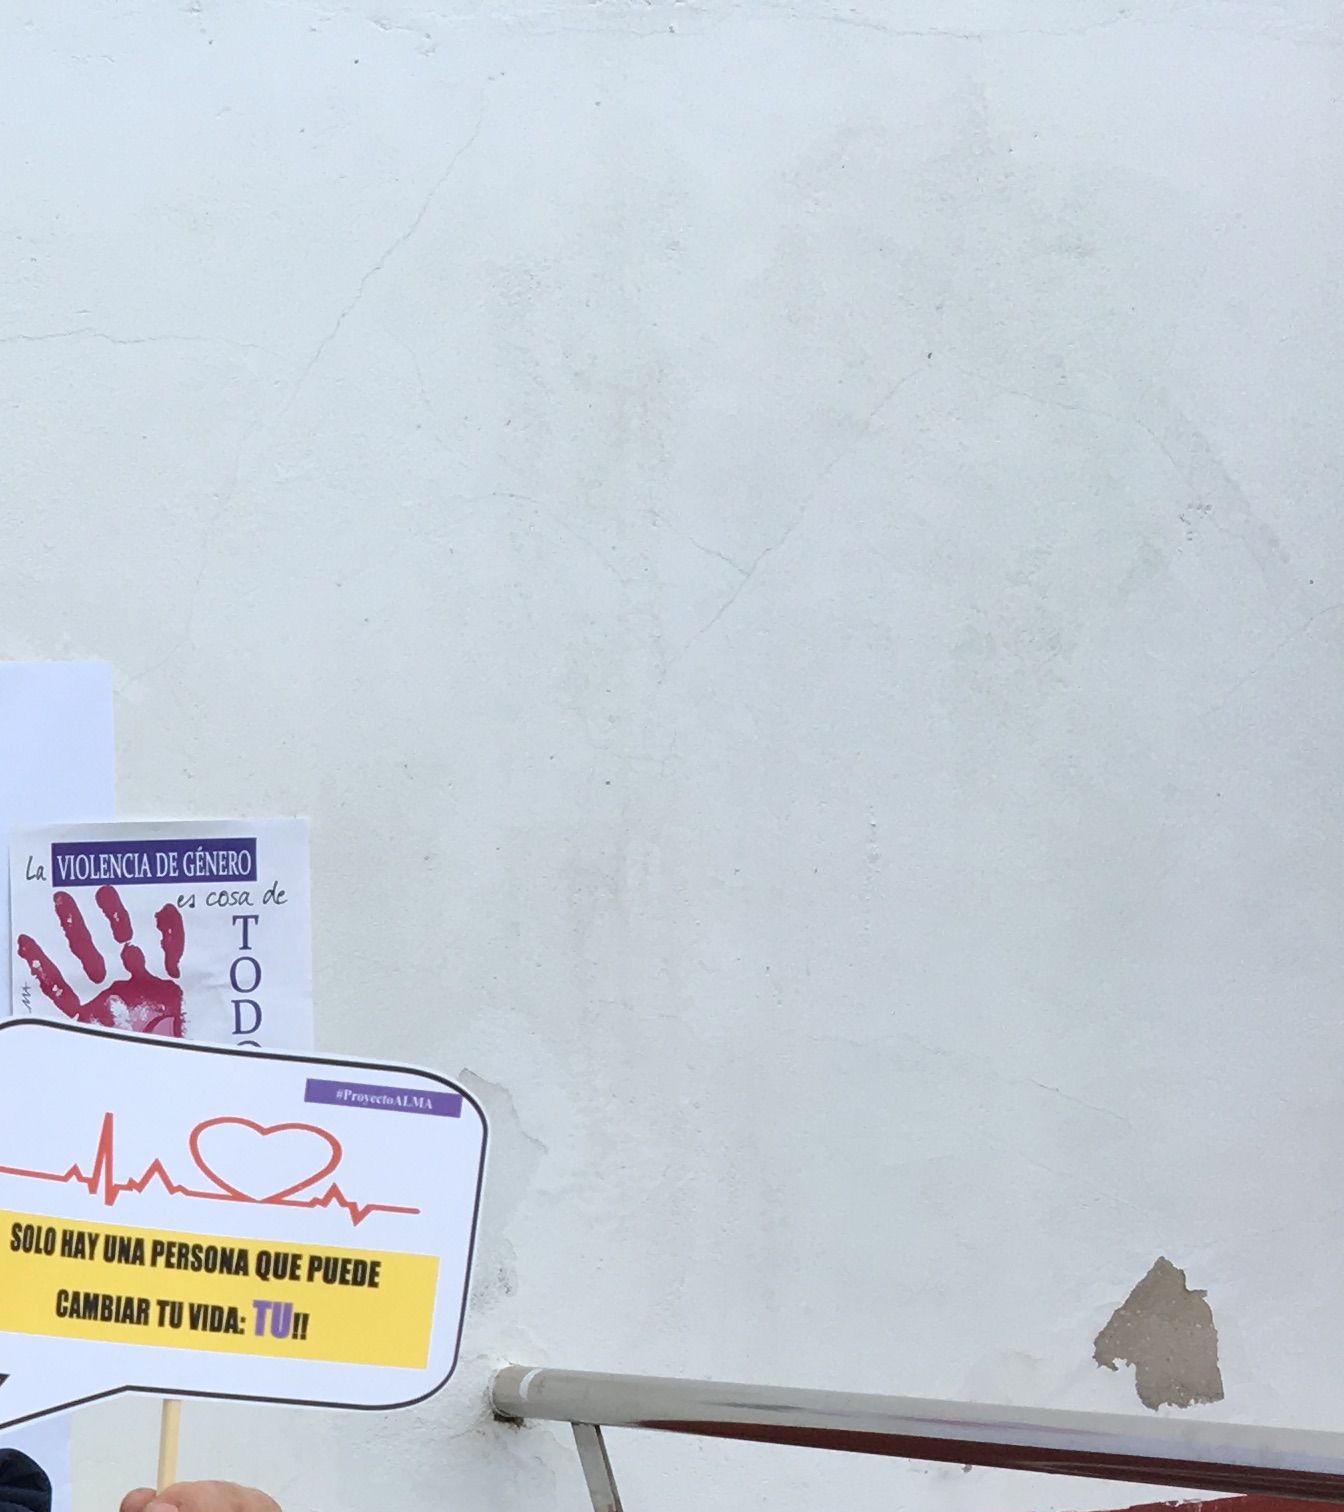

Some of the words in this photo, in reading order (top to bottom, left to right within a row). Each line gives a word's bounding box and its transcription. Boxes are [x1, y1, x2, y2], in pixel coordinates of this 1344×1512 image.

[26, 856, 47, 880] La
[57, 854, 151, 880] VIOLENCIA
[156, 852, 179, 876] DE
[183, 846, 252, 877] GÉNERO
[177, 894, 195, 908] es
[206, 888, 254, 907] cosa
[262, 881, 288, 904] de
[230, 915, 262, 1047] TOD
[336, 1089, 433, 1110] #ProyectoALMA
[10, 1223, 55, 1256] SOLO
[61, 1229, 98, 1260] HAY
[102, 1235, 145, 1266] UNA
[150, 1240, 249, 1276] PERSONA
[255, 1250, 301, 1282] QUE
[307, 1256, 381, 1288] PUEDE
[55, 1288, 149, 1326] CAMBIAR
[156, 1300, 184, 1329] TU
[189, 1303, 245, 1335] VIDA:
[252, 1299, 309, 1341] TU!!
